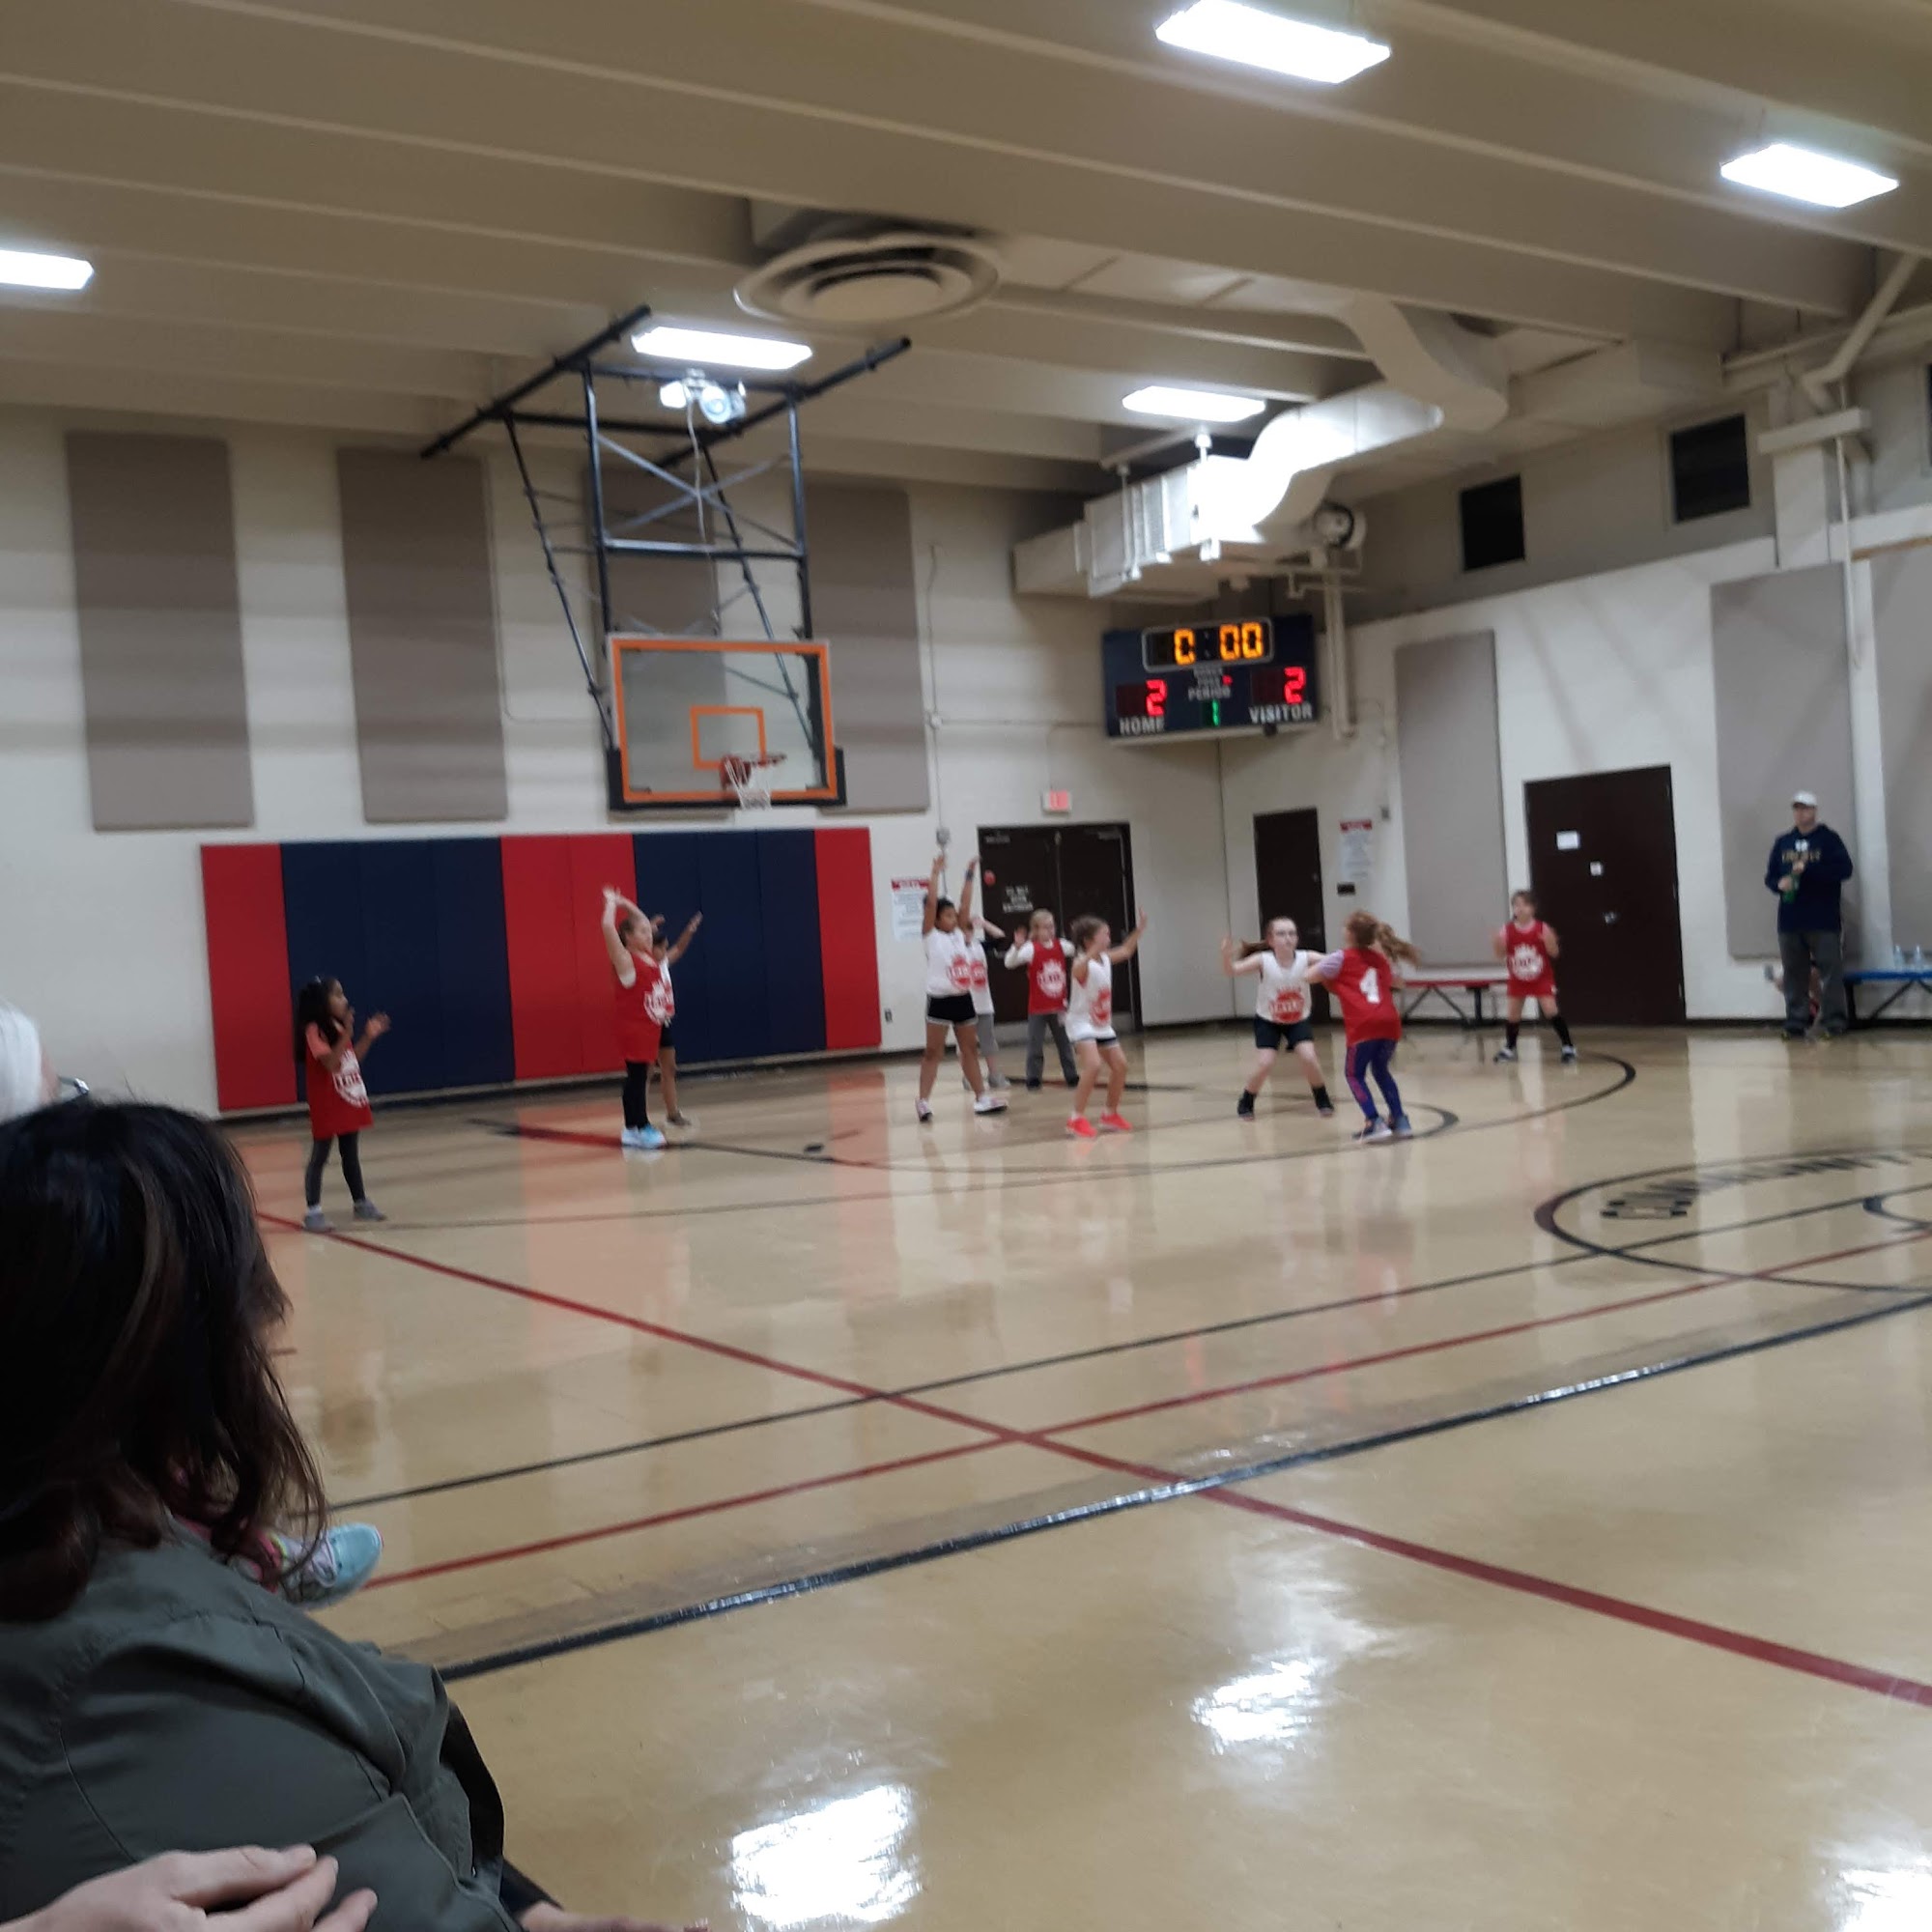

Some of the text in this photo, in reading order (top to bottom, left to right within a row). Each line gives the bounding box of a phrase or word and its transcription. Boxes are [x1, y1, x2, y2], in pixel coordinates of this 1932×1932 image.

[1146, 679, 1168, 716] 2
[1284, 667, 1306, 704] 2
[1119, 716, 1165, 734] HOME
[1211, 699, 1220, 726] 1
[1249, 701, 1313, 724] VISITOR
[1359, 967, 1380, 1004] 4
